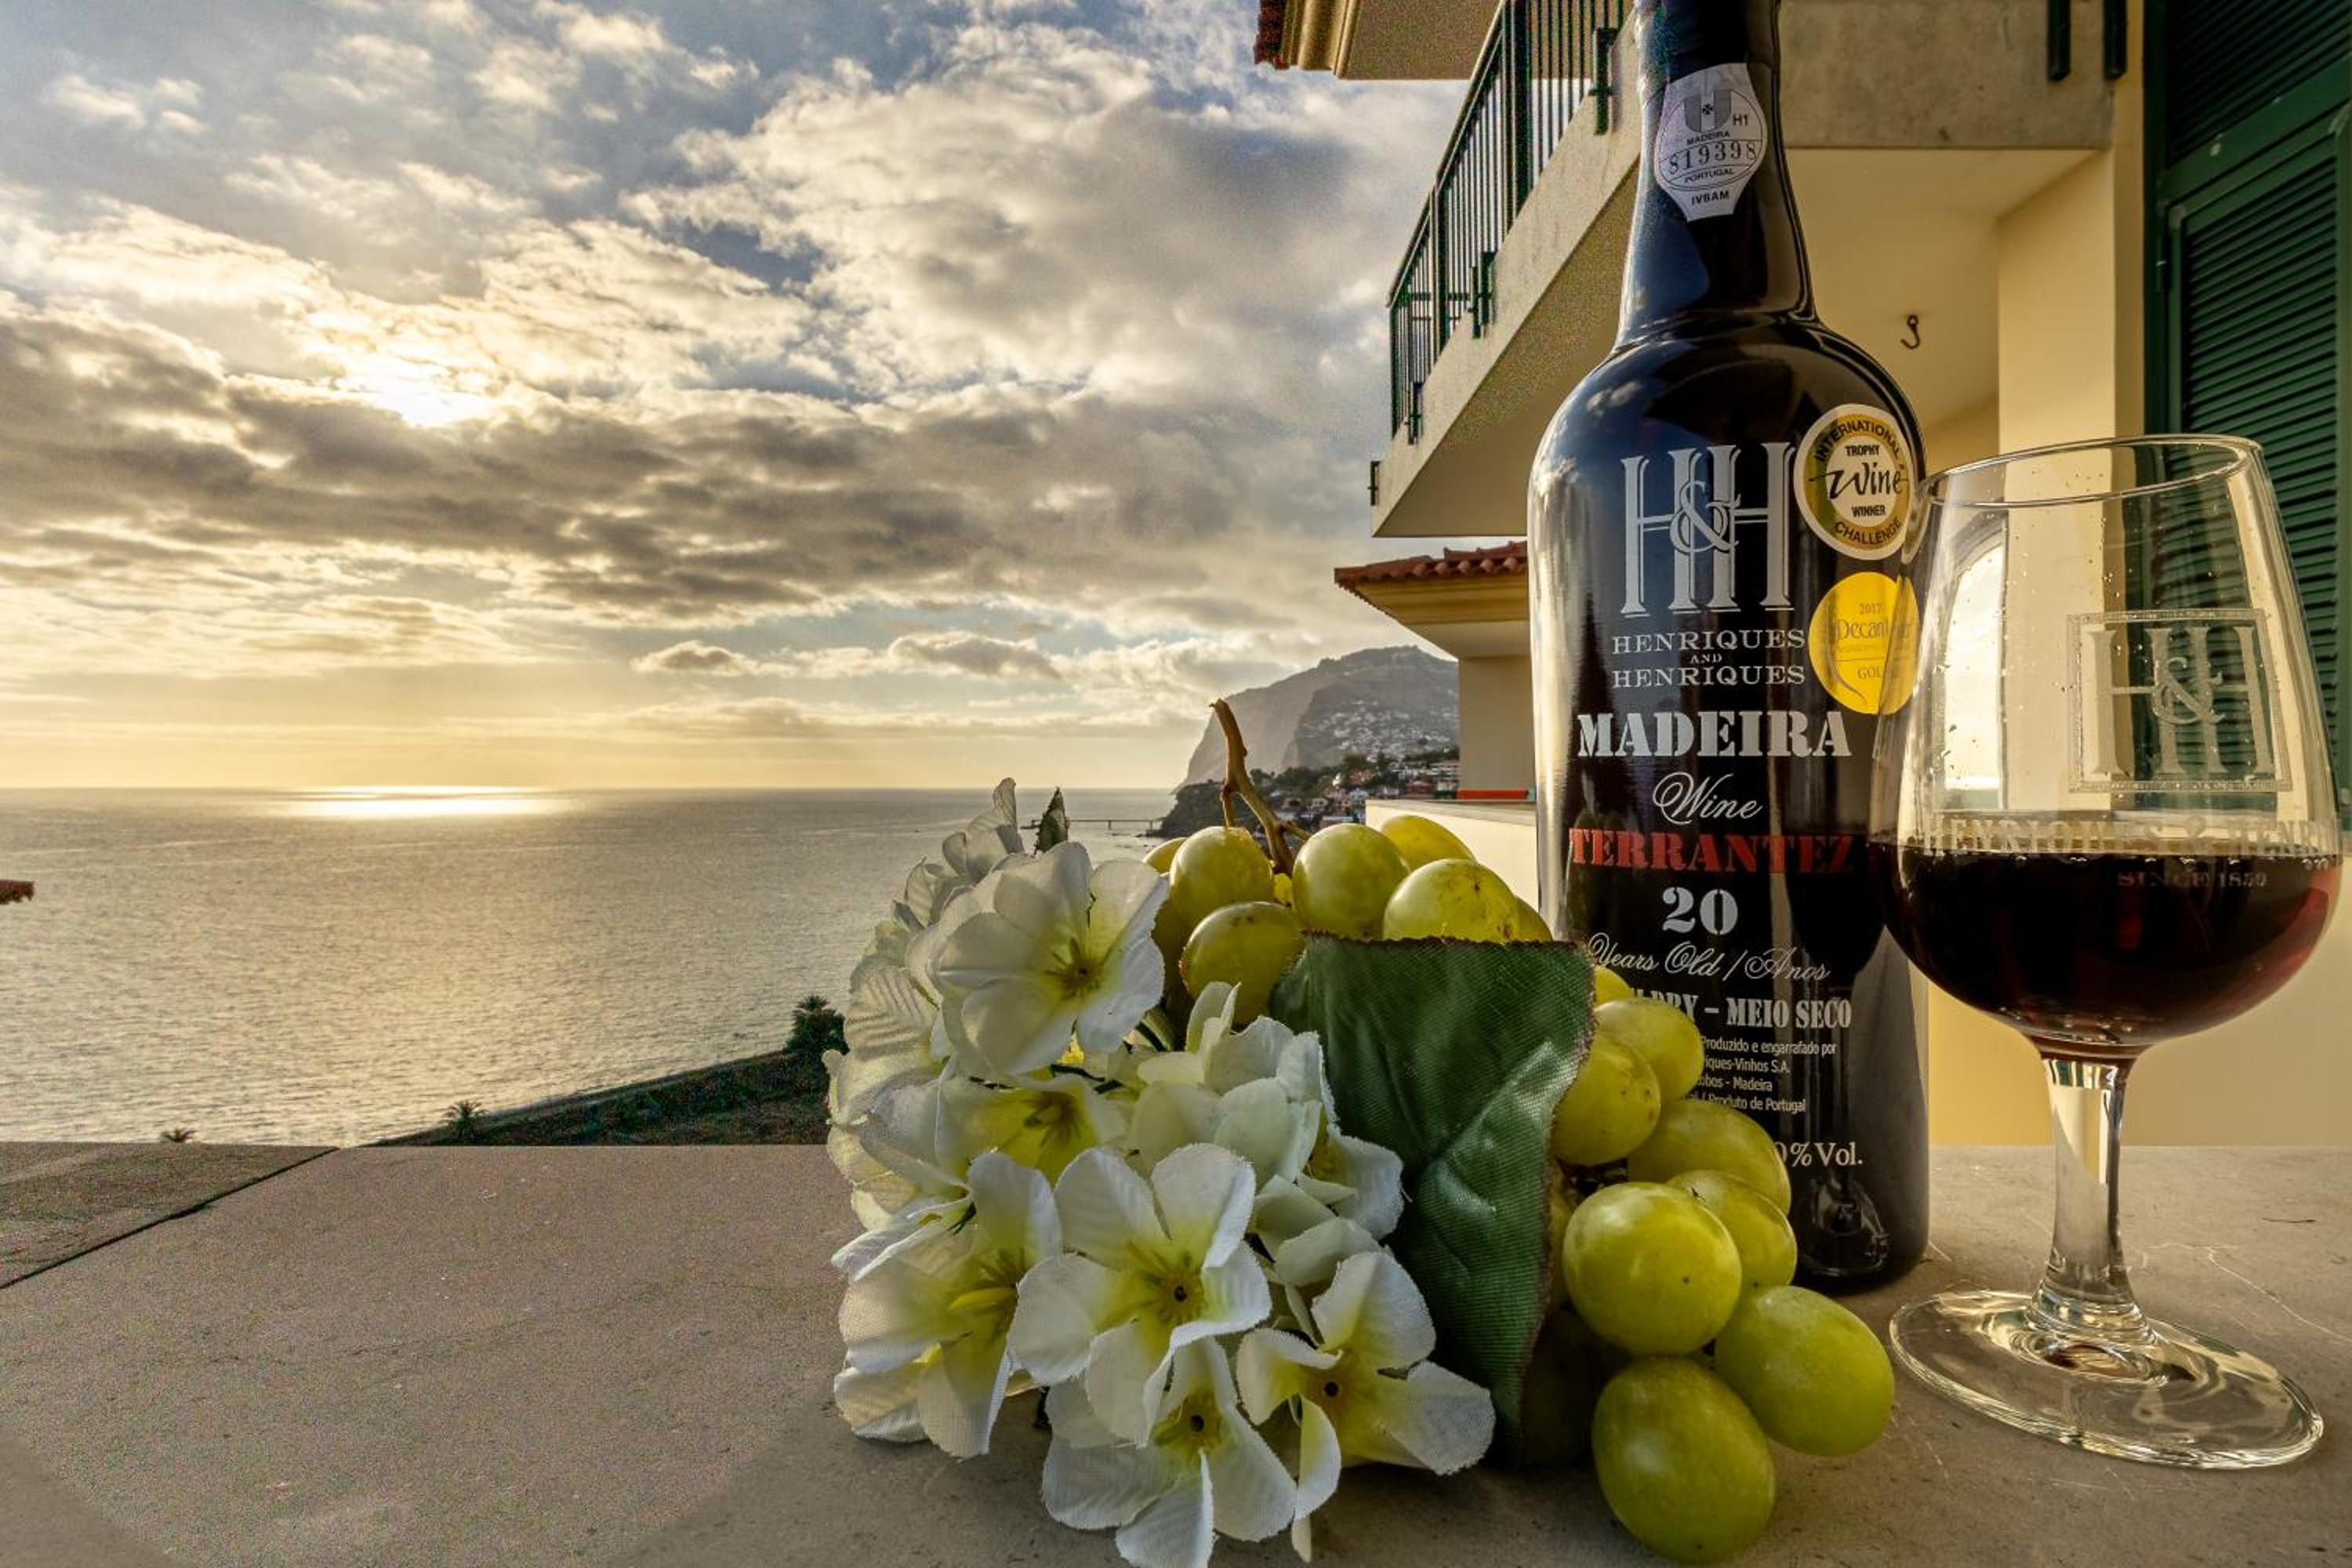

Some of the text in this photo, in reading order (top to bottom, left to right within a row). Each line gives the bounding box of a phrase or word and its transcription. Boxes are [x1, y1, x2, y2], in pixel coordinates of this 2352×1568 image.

[1733, 114, 1748, 126] H1
[1687, 131, 1731, 145] MADEIRA
[1668, 141, 1757, 175] 819398
[1685, 168, 1734, 183] PORTUGAL
[1691, 191, 1730, 205] IVBAM
[1814, 419, 1900, 462] INTERNATIONAL
[1844, 445, 1881, 457] TROPHY
[1807, 461, 1908, 499] Wine
[1851, 504, 1886, 518] WINNER
[1834, 517, 1901, 544] CHALLENGE
[1835, 617, 1890, 641] Decan
[1612, 629, 1806, 655] HENRIQUES
[1689, 653, 1723, 665] AND
[1612, 665, 1806, 689] HENRIQUES
[1857, 666, 1885, 679] GOL
[1577, 710, 1853, 757] MADEIRA
[1652, 771, 1763, 826] Wine
[1568, 827, 1854, 874] TERRANTEZ
[1662, 887, 1738, 935] 20
[1588, 932, 1660, 971] Years
[1664, 941, 1726, 977] Old
[1744, 946, 1832, 981] Anos
[1726, 997, 1790, 1029] MEIO
[1795, 999, 1853, 1029] SECO
[1751, 1044, 1759, 1053] e
[1761, 1040, 1820, 1057] engarrafado
[1821, 1044, 1837, 1058] por
[1705, 1055, 1791, 1073] iques-Vinhos S.A.
[1698, 1073, 1723, 1088] obos
[1733, 1076, 1773, 1092] Madeira
[1750, 1095, 1763, 1111] de
[1766, 1098, 1806, 1115] Portugal
